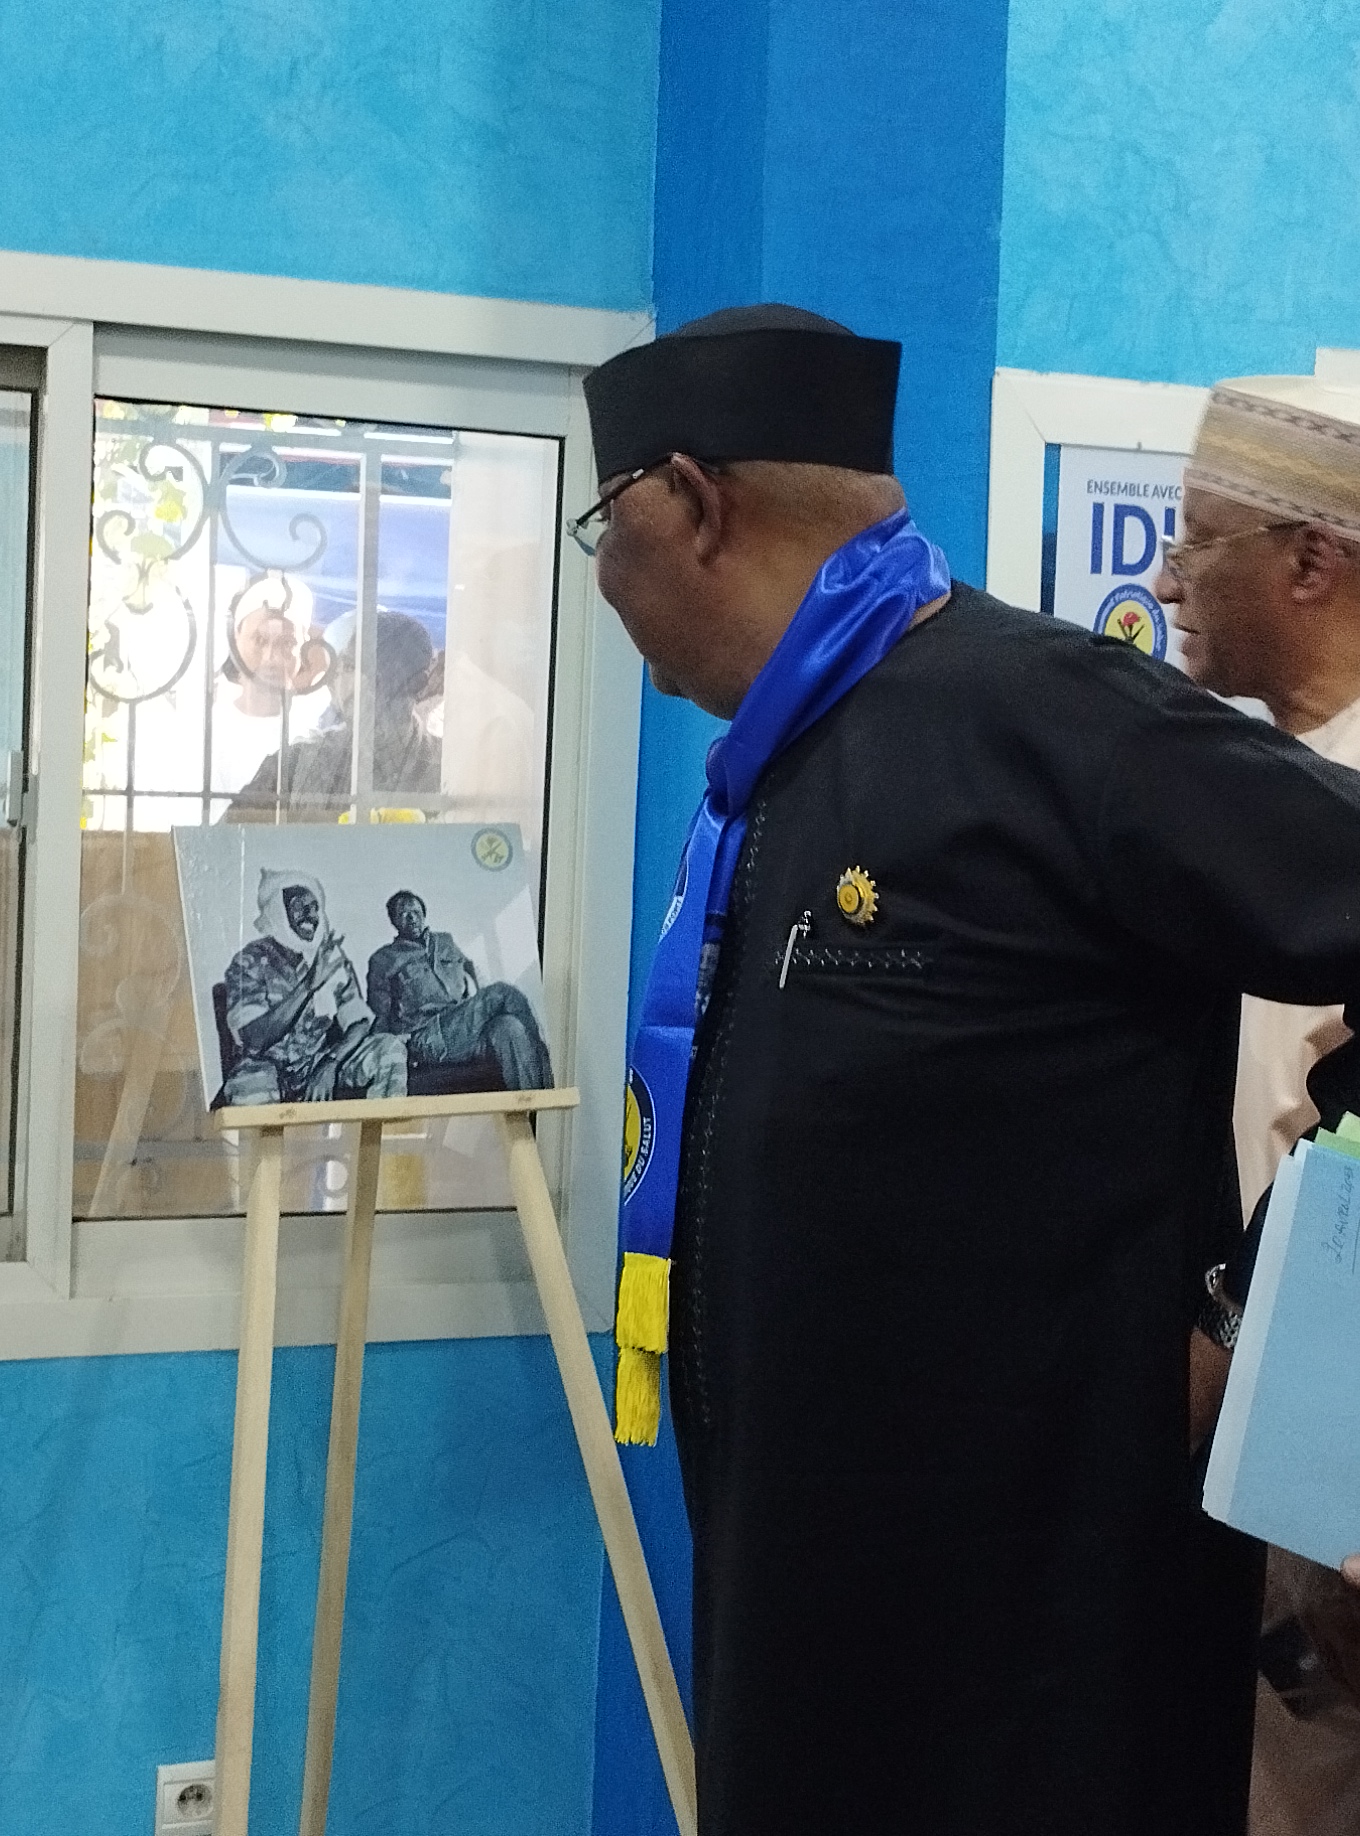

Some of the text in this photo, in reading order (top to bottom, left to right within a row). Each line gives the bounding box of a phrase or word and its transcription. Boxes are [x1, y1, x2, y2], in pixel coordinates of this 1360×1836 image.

[1086, 479, 1182, 500] ENSEMBLE AVEC
[641, 1116, 652, 1157] SALUT
